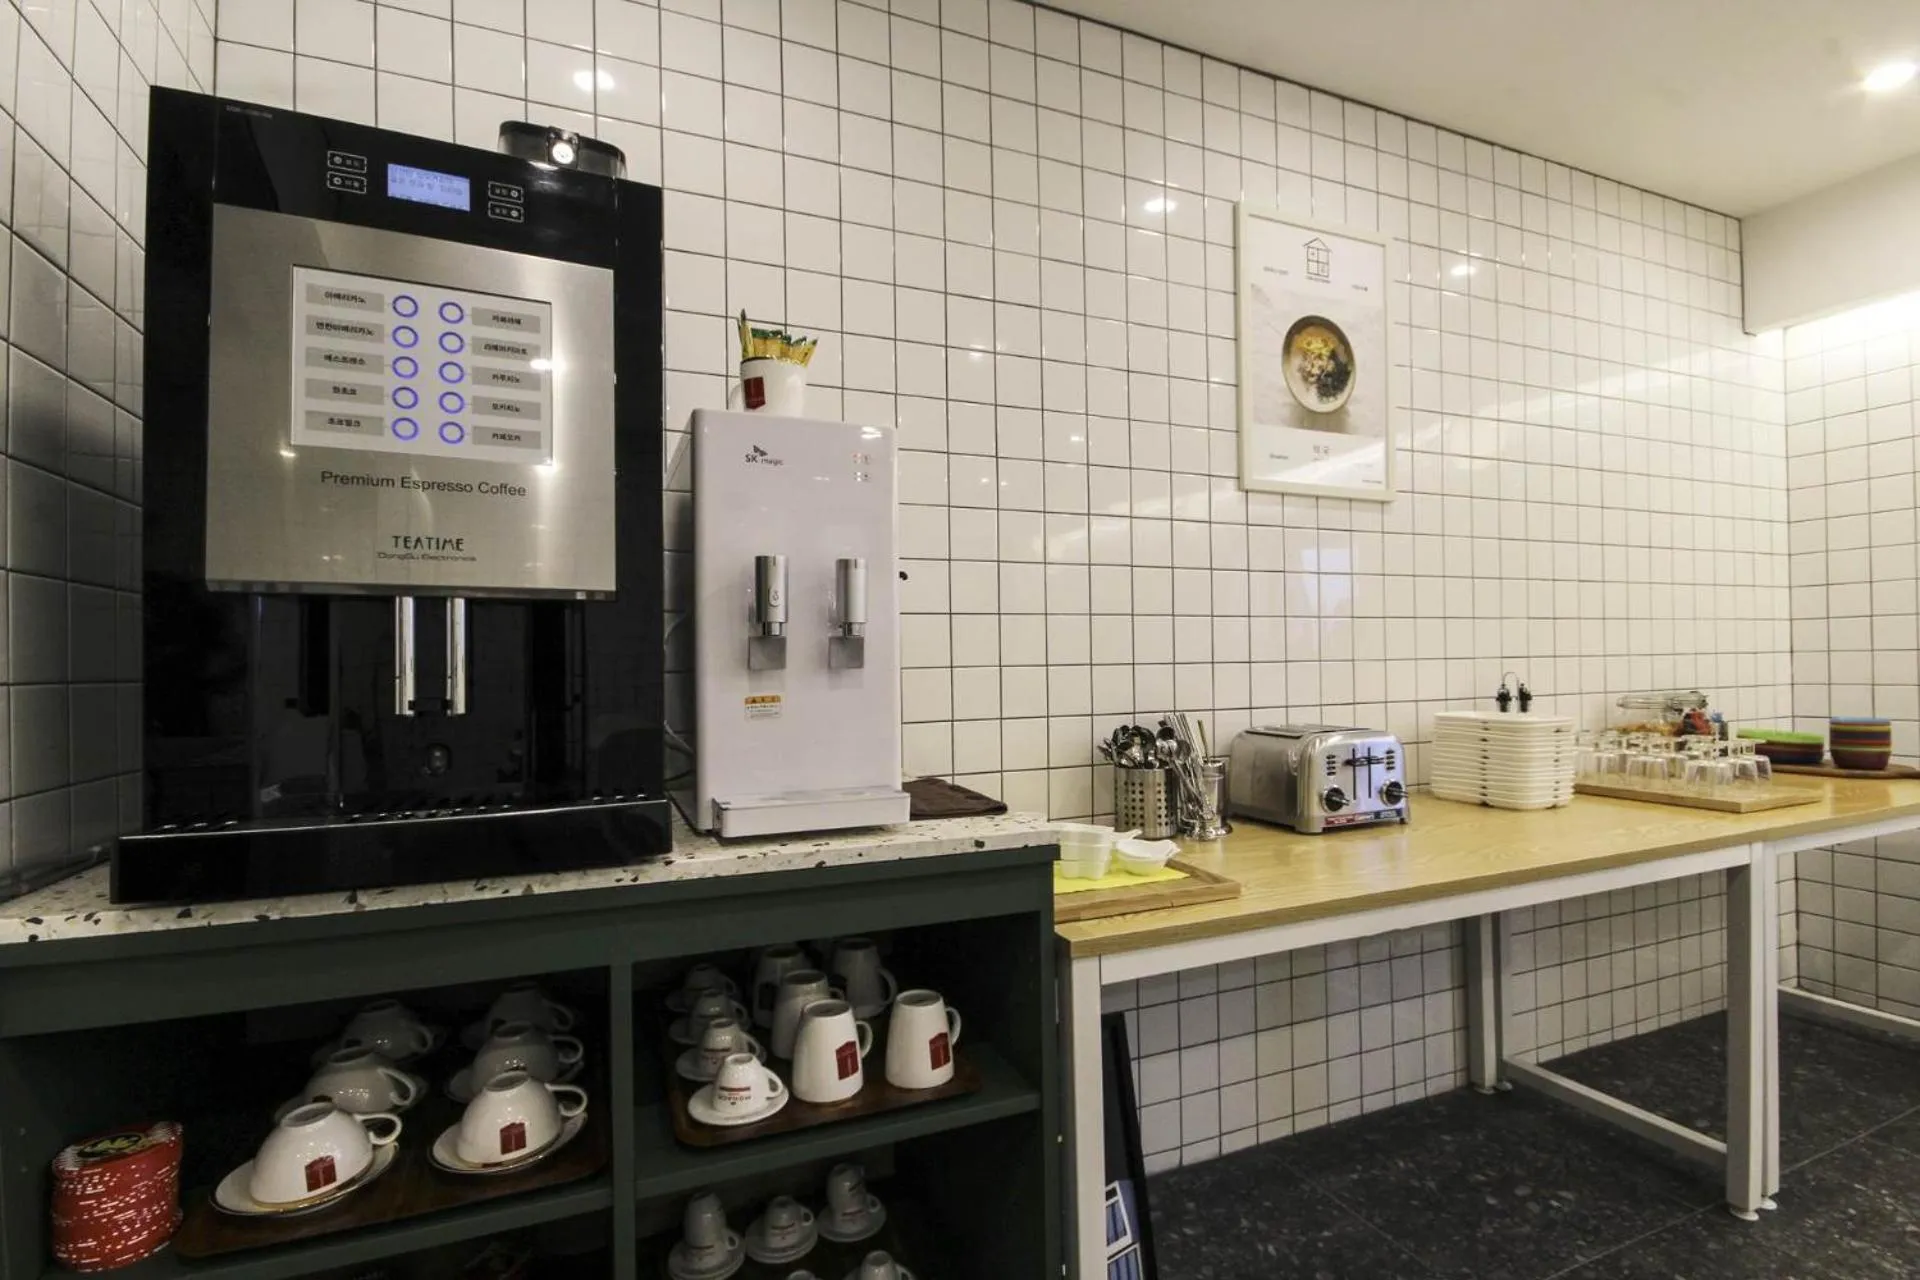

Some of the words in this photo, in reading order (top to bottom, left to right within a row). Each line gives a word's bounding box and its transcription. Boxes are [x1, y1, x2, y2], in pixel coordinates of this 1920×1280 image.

[745, 453, 758, 463] SK
[320, 470, 395, 488] Premium
[400, 476, 473, 494] Espresso
[478, 481, 527, 497] Coffee
[392, 535, 465, 552] TEATIME
